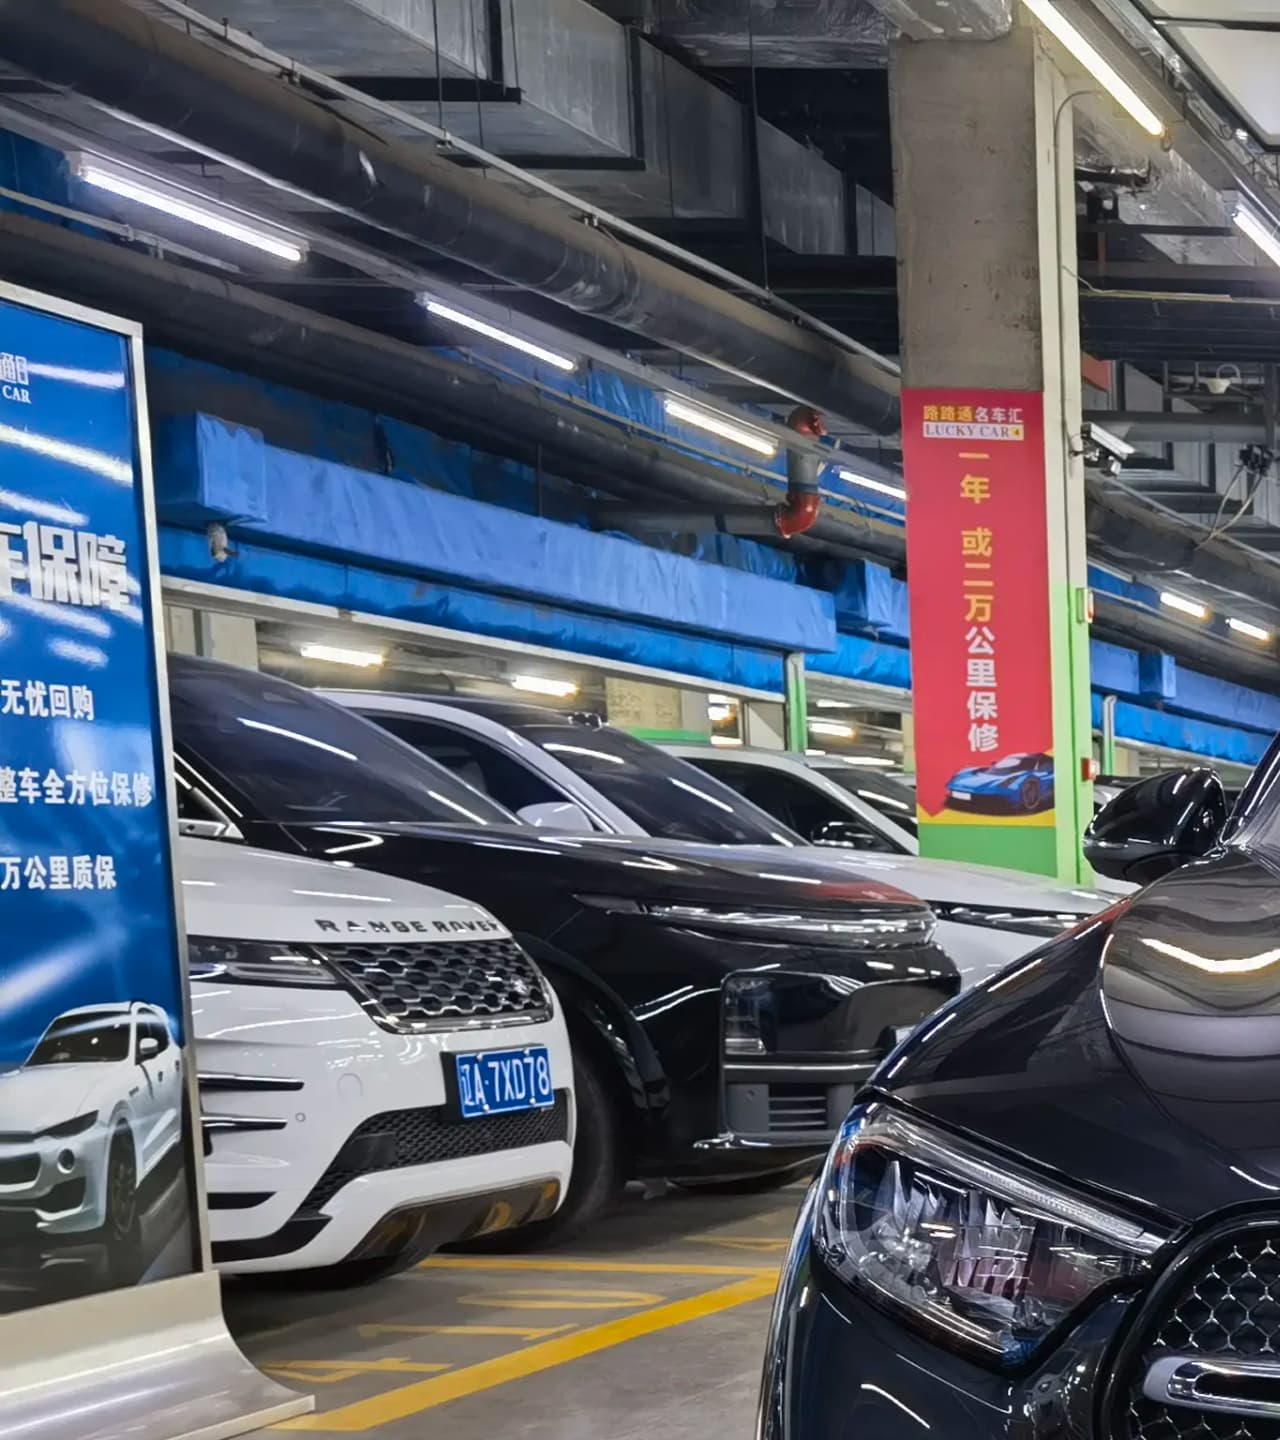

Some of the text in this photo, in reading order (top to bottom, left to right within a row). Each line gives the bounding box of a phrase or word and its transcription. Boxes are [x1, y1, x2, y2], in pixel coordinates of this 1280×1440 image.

[925, 423, 1010, 438] LUCKY CAR
[0, 679, 94, 720] 无忧回购
[0, 766, 152, 807] 整车全方位保修
[0, 854, 117, 890] 万公里质保
[314, 918, 427, 933] RANGE
